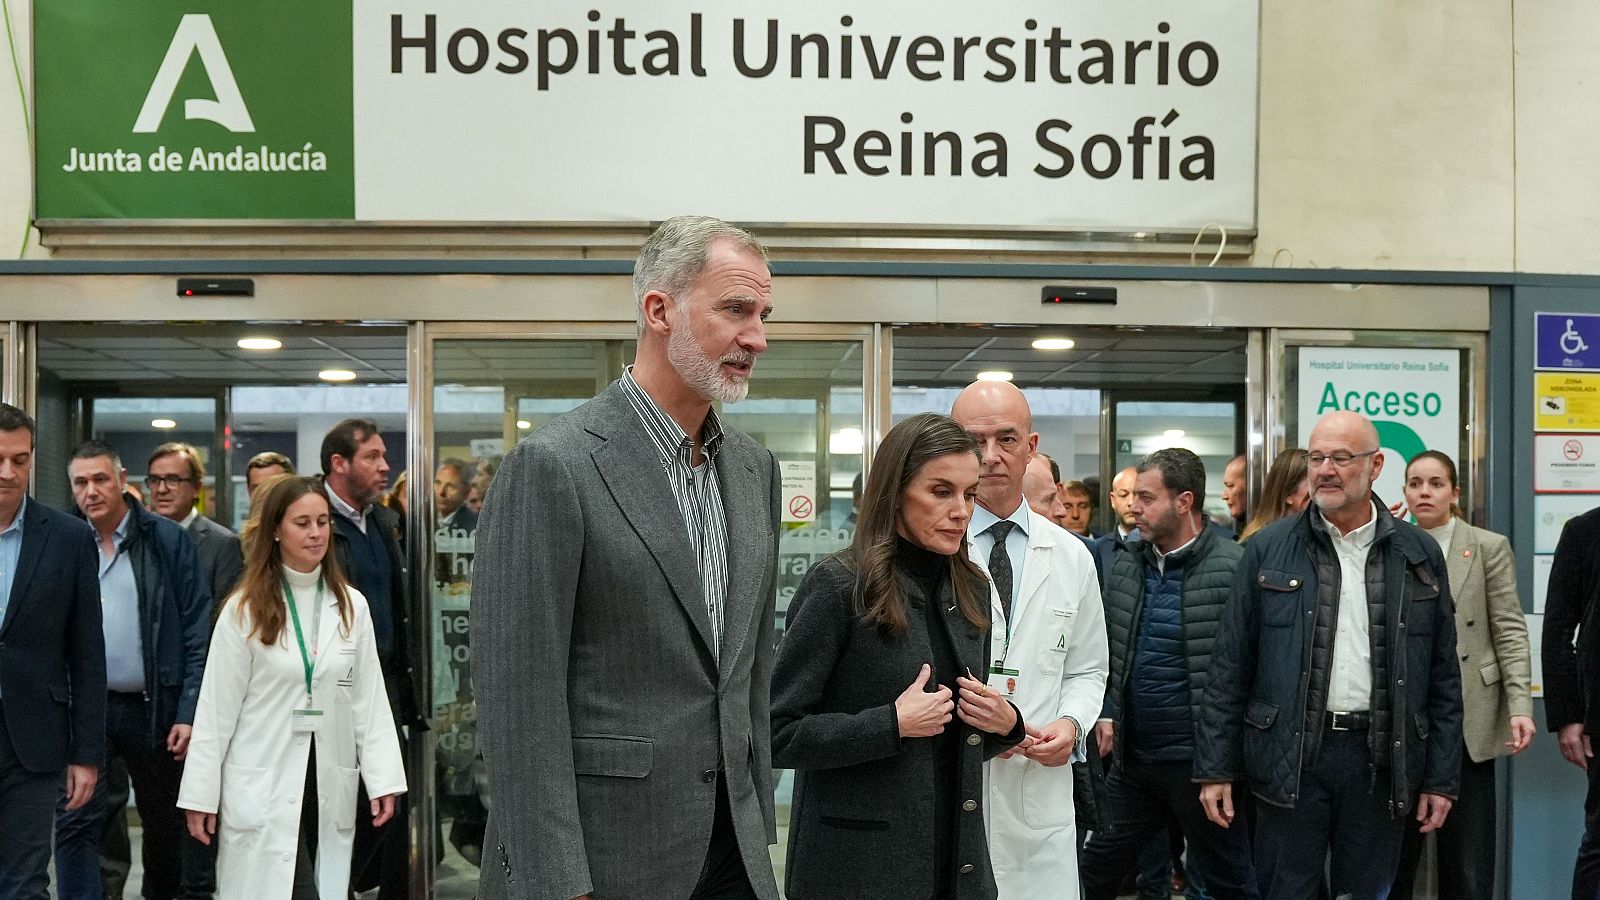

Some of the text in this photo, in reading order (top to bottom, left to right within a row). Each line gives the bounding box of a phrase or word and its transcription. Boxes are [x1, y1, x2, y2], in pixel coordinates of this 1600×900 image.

[390, 9, 1219, 90] Hospital Universitario
[62, 142, 327, 173] Junta de Andalucía
[803, 108, 1216, 182] Reina Sofía
[1309, 360, 1344, 371] Hospital
[1346, 361, 1400, 371] Universitario
[1402, 362, 1426, 371] Reina
[1316, 381, 1442, 417] Acceso
